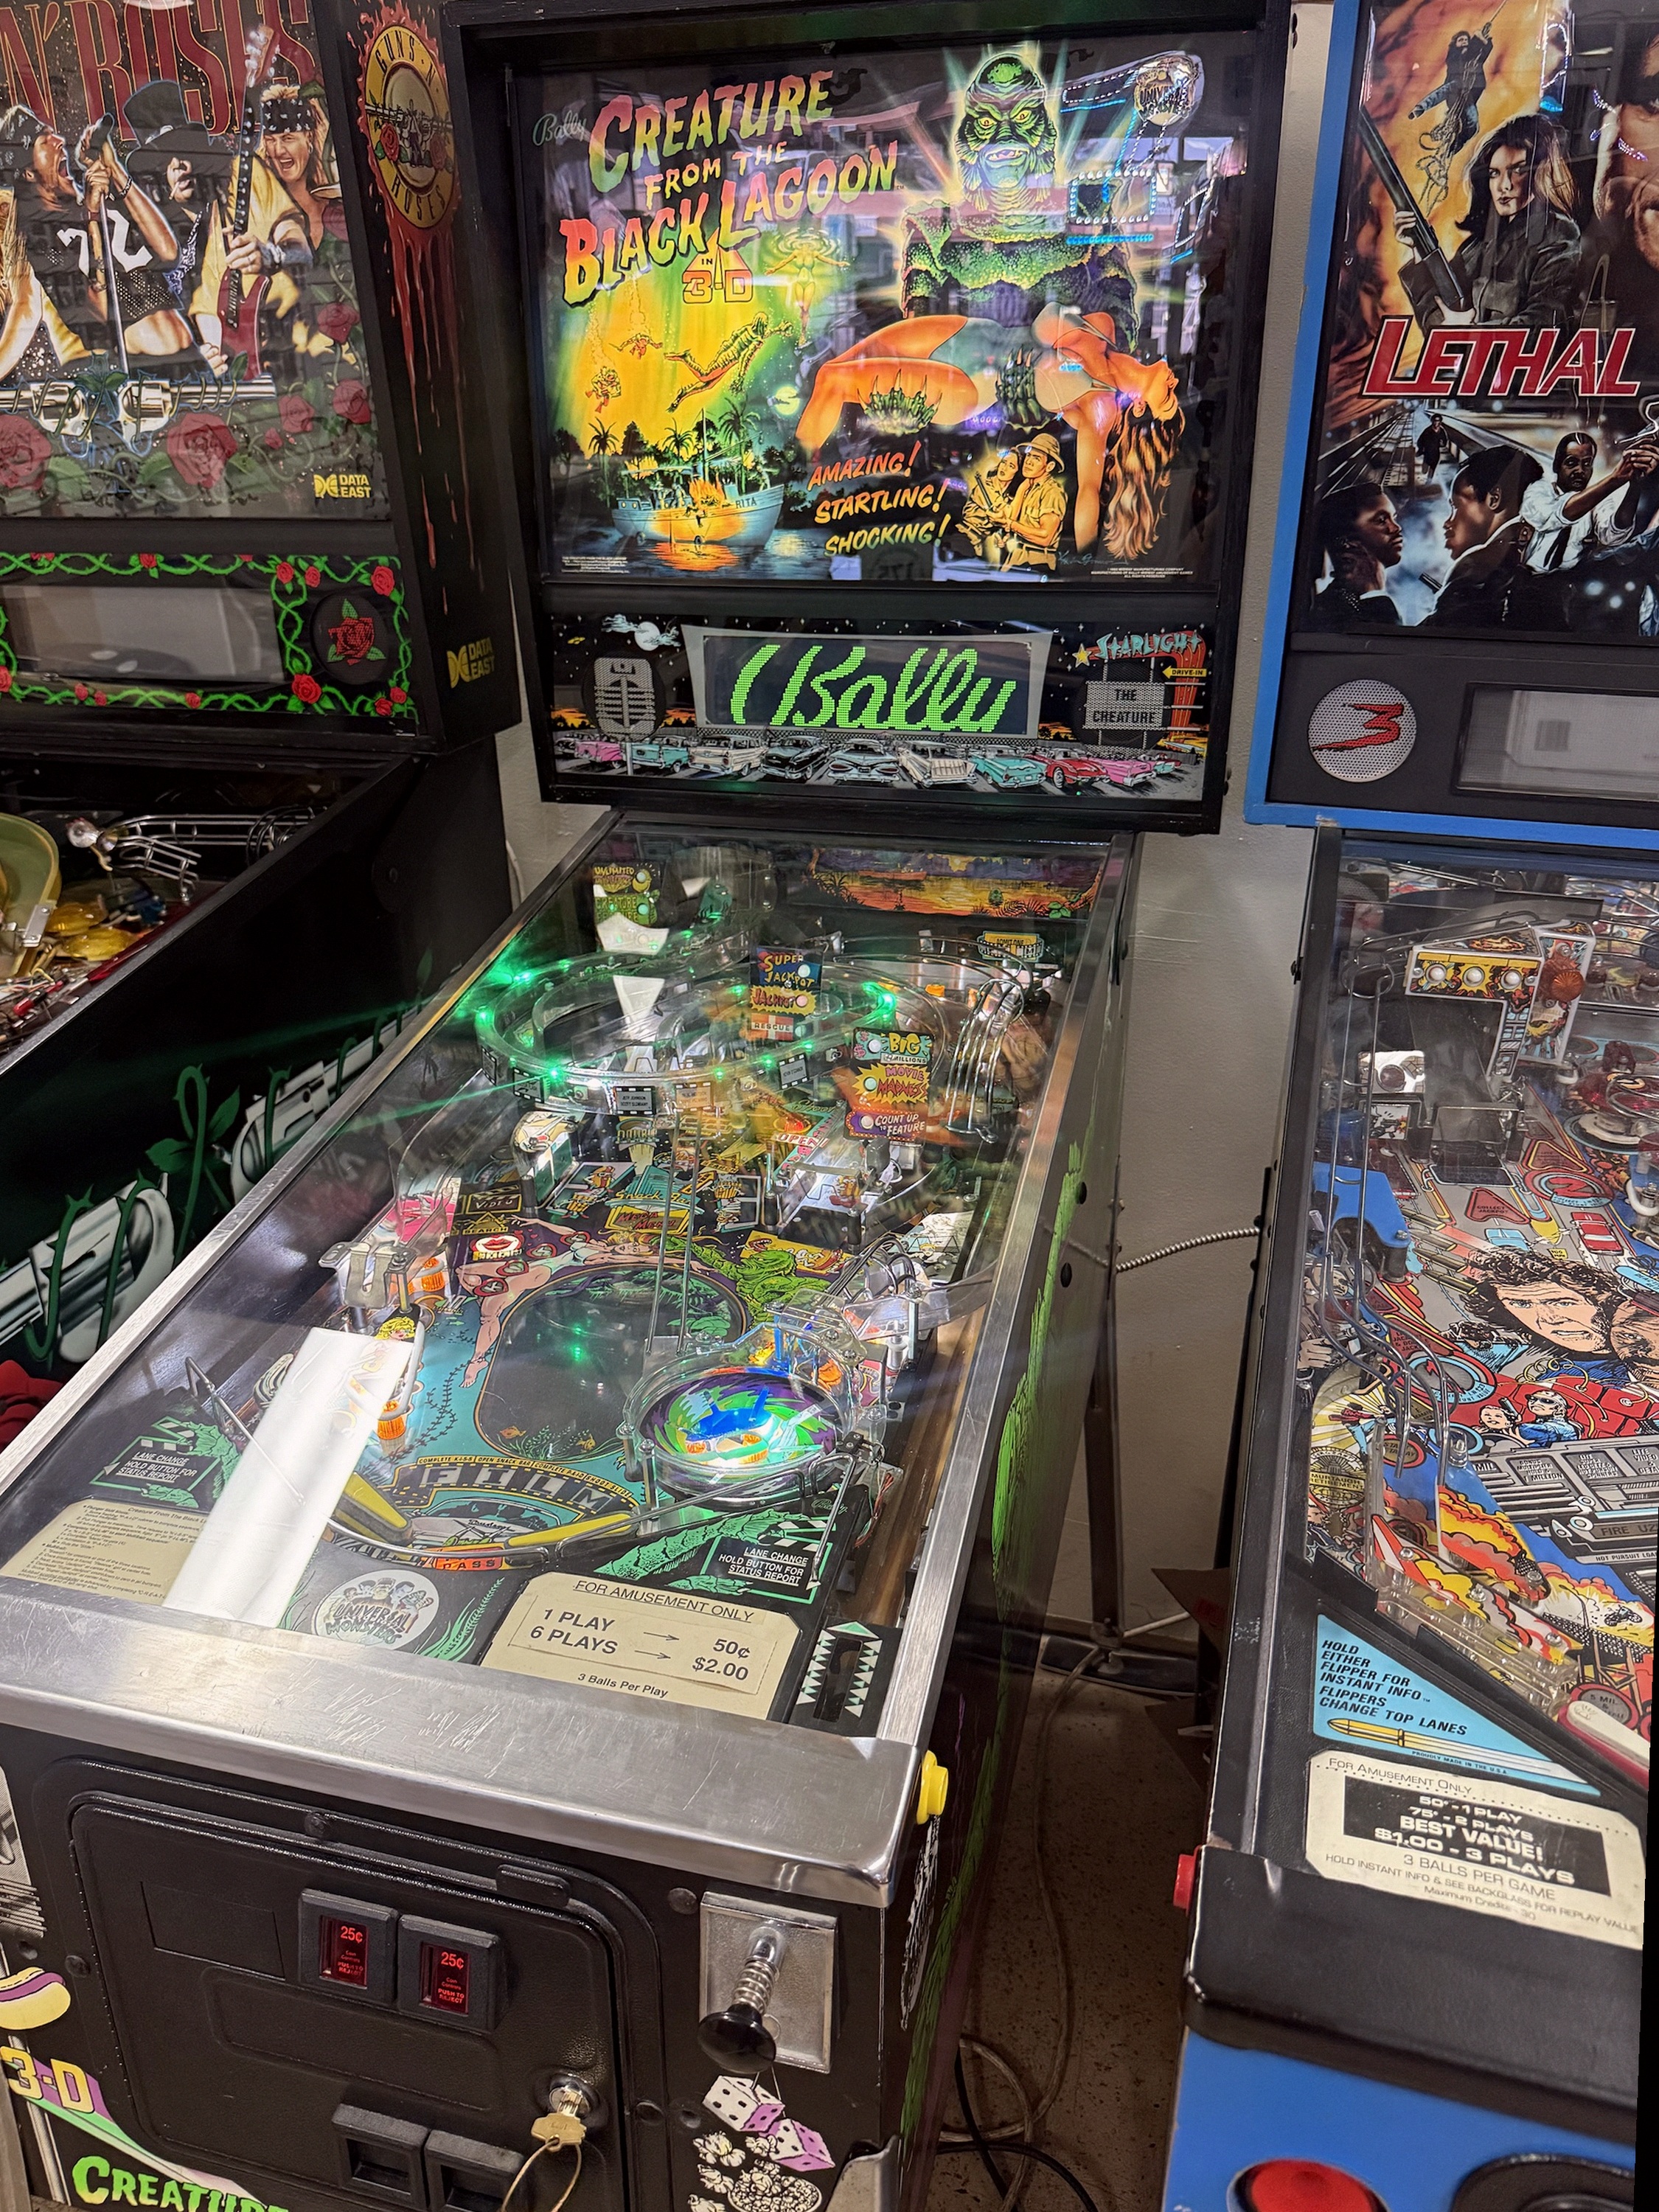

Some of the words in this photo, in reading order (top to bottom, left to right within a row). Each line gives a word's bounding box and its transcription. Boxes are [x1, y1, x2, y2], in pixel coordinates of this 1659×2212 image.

[375, 30, 415, 74] GUNS
[532, 111, 588, 147] Bally
[589, 70, 833, 193] CREATURE
[644, 158, 722, 210] FROM
[732, 140, 787, 175] THE
[560, 192, 711, 307] BLACK
[718, 139, 898, 251] LAGOON
[700, 257, 713, 265] IN
[1360, 316, 1641, 398] LETHAL
[808, 440, 922, 490] AMAZING!
[339, 474, 369, 486] DATA
[341, 487, 371, 498] EAST
[814, 479, 948, 524] STARTLING!
[824, 513, 951, 558] SHOCKING!
[468, 637, 493, 660] DATA
[1095, 630, 1202, 660] STARLIGHT
[470, 655, 495, 681] EAST
[729, 643, 1017, 732] Bally
[1116, 689, 1136, 700] THE
[1093, 710, 1156, 723] CREATURE
[594, 866, 635, 875] UNLIMITED
[596, 897, 636, 909] CREATURE
[764, 954, 804, 973] SUPER
[765, 971, 815, 988] JACKPOT
[754, 1022, 790, 1031] RESCUE
[888, 1032, 921, 1055] BIG
[886, 1067, 925, 1082] MOVIE
[876, 1079, 928, 1097] MADNESS
[875, 1116, 905, 1127] COUNT
[906, 1113, 919, 1123] UP
[886, 1120, 926, 1136] FEATURE
[475, 1200, 513, 1210] VIDEO
[615, 1191, 661, 1200] Snack
[619, 1211, 658, 1222] MEGA
[133, 1451, 157, 1461] LANE
[156, 1454, 189, 1465] CHANGE
[1634, 1453, 1658, 1461] VIDEO
[118, 1467, 148, 1477] STATUS
[147, 1470, 181, 1482] REPORT
[124, 1460, 148, 1470] HOLD
[147, 1464, 180, 1474] BUTTON
[178, 1468, 198, 1477] FOR
[534, 1462, 566, 1473] COMPLETE
[1531, 1473, 1564, 1481] MILLION
[586, 1474, 609, 1487] SHOOT
[611, 1484, 633, 1498] SLIDE
[1311, 1473, 1361, 1485] MURTAUGH
[1601, 1526, 1630, 1536] FIRE
[718, 1554, 744, 1565] HOLD
[745, 1559, 783, 1573] BUTTON
[784, 1565, 804, 1576] FOR
[745, 1546, 769, 1558] LANE
[771, 1551, 809, 1565] CHANGE
[728, 1564, 762, 1577] STATUS
[764, 1571, 801, 1585] REPORT
[574, 1580, 608, 1595] FOR
[611, 1587, 709, 1613] AMUSEMENT
[710, 1605, 755, 1622] ONLY
[333, 1601, 411, 1633] UNIVERSAL
[325, 1618, 403, 1644] MONSTERS
[543, 1609, 554, 1620] 1
[557, 1610, 616, 1632] PLAY
[712, 1638, 751, 1659] 50¢
[530, 1625, 545, 1639] 6
[547, 1628, 618, 1655] PLAYS
[692, 1656, 749, 1681] $2.00
[1321, 1640, 1359, 1655] HOLD
[1321, 1651, 1371, 1668] EITHER
[1320, 1661, 1377, 1680] FLIPPER
[1382, 1673, 1411, 1687] FOR
[577, 1672, 585, 1682] 3
[588, 1674, 617, 1689] Balls
[619, 1681, 641, 1692] Per
[642, 1684, 669, 1699] Play
[1320, 1672, 1384, 1692] INSTANT
[1387, 1685, 1422, 1700] INFO
[1319, 1686, 1387, 1707] FLIPPERS
[1599, 1696, 1615, 1704] MIL
[1319, 1697, 1380, 1717] CHANGE
[1385, 1709, 1413, 1724] TOP
[1418, 1717, 1467, 1736] LANES
[1412, 1750, 1441, 1760] PROUDLY
[1443, 1756, 1463, 1765] MADE
[1329, 1758, 1354, 1771] FOR
[1357, 1762, 1433, 1788] AMUSEMENT
[1437, 1778, 1472, 1795] ONLY
[1473, 1806, 1523, 1825] PLAY
[1455, 1814, 1468, 1824] 2
[1472, 1818, 1534, 1843] PLAYS
[1401, 1815, 1456, 1838] BEST
[1461, 1828, 1544, 1862] VALUE!
[1374, 1827, 1444, 1853] $1.00
[1466, 1847, 1484, 1861] 3
[1489, 1852, 1576, 1885] PLAYS
[1403, 1854, 1414, 1866] 3
[1419, 1855, 1468, 1878] BALLS
[1472, 1868, 1504, 1886] PER
[1508, 1878, 1556, 1900] GAME
[1325, 1853, 1355, 1867] HOLD
[1357, 1859, 1402, 1877] INSTANT
[1405, 1869, 1430, 1884] INFO
[1433, 1875, 1441, 1885] &
[1444, 1877, 1466, 1891] SEE
[1467, 1881, 1532, 1909] BACKGLASS
[1534, 1899, 1557, 1914] FOR
[1559, 1905, 1601, 1925] REPLAY
[1601, 1917, 1638, 1934] VALUE
[1424, 1885, 1472, 1905] Maximum
[1473, 1895, 1511, 1912] Credits
[1522, 1910, 1537, 1922] 30
[340, 1925, 364, 1944] 25¢
[345, 1949, 357, 1957] Coin
[440, 1951, 465, 1970] 25¢
[445, 1976, 458, 1984] Coin
[437, 1988, 456, 1997] PUSH
[1, 2046, 95, 2113] 3-D
